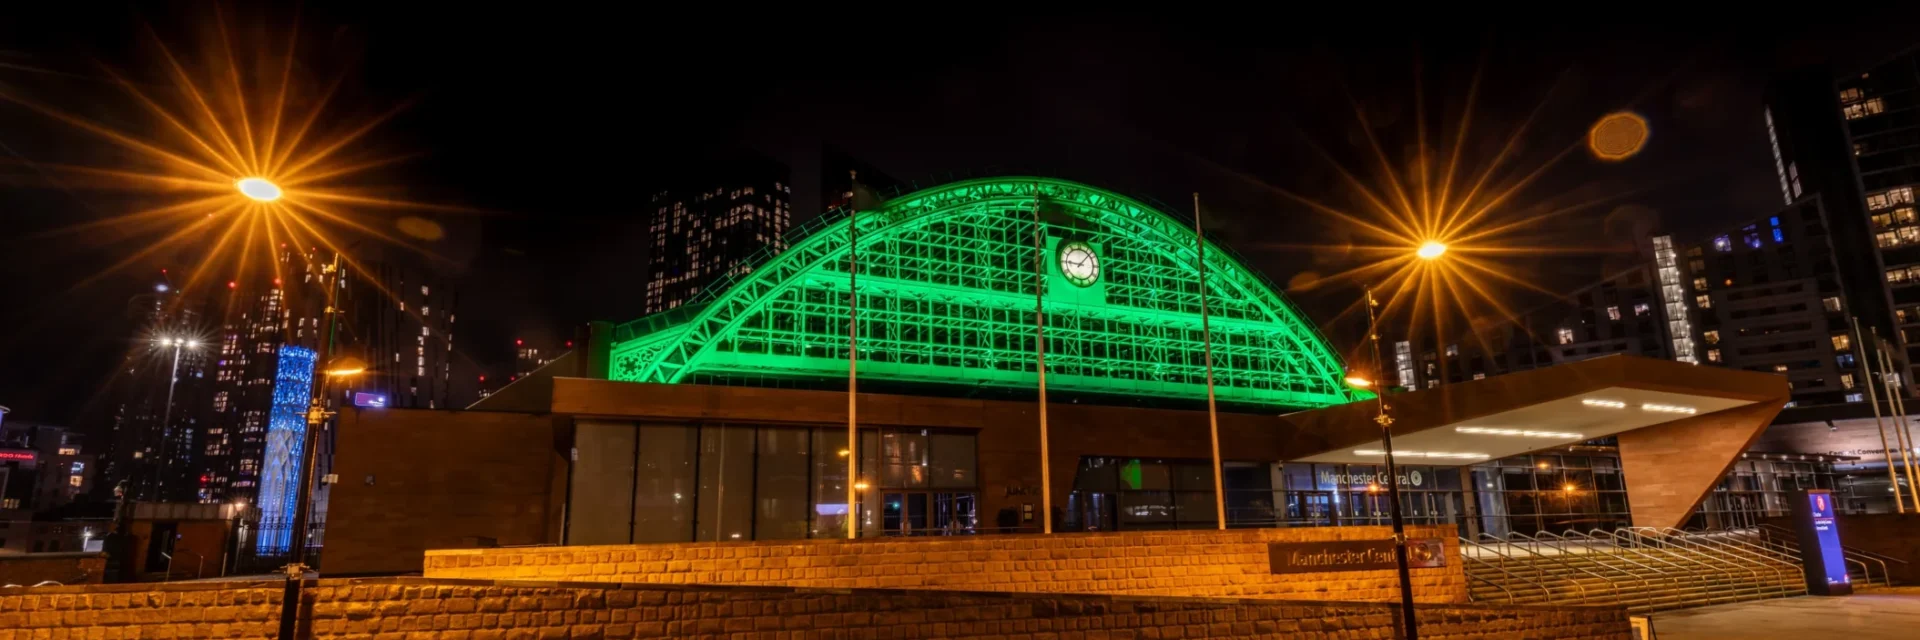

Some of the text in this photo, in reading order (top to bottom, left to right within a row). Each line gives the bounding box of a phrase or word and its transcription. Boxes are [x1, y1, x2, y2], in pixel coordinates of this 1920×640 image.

[1321, 471, 1411, 485] Manchester Cetral
[1287, 547, 1415, 567] Manchester Centl
